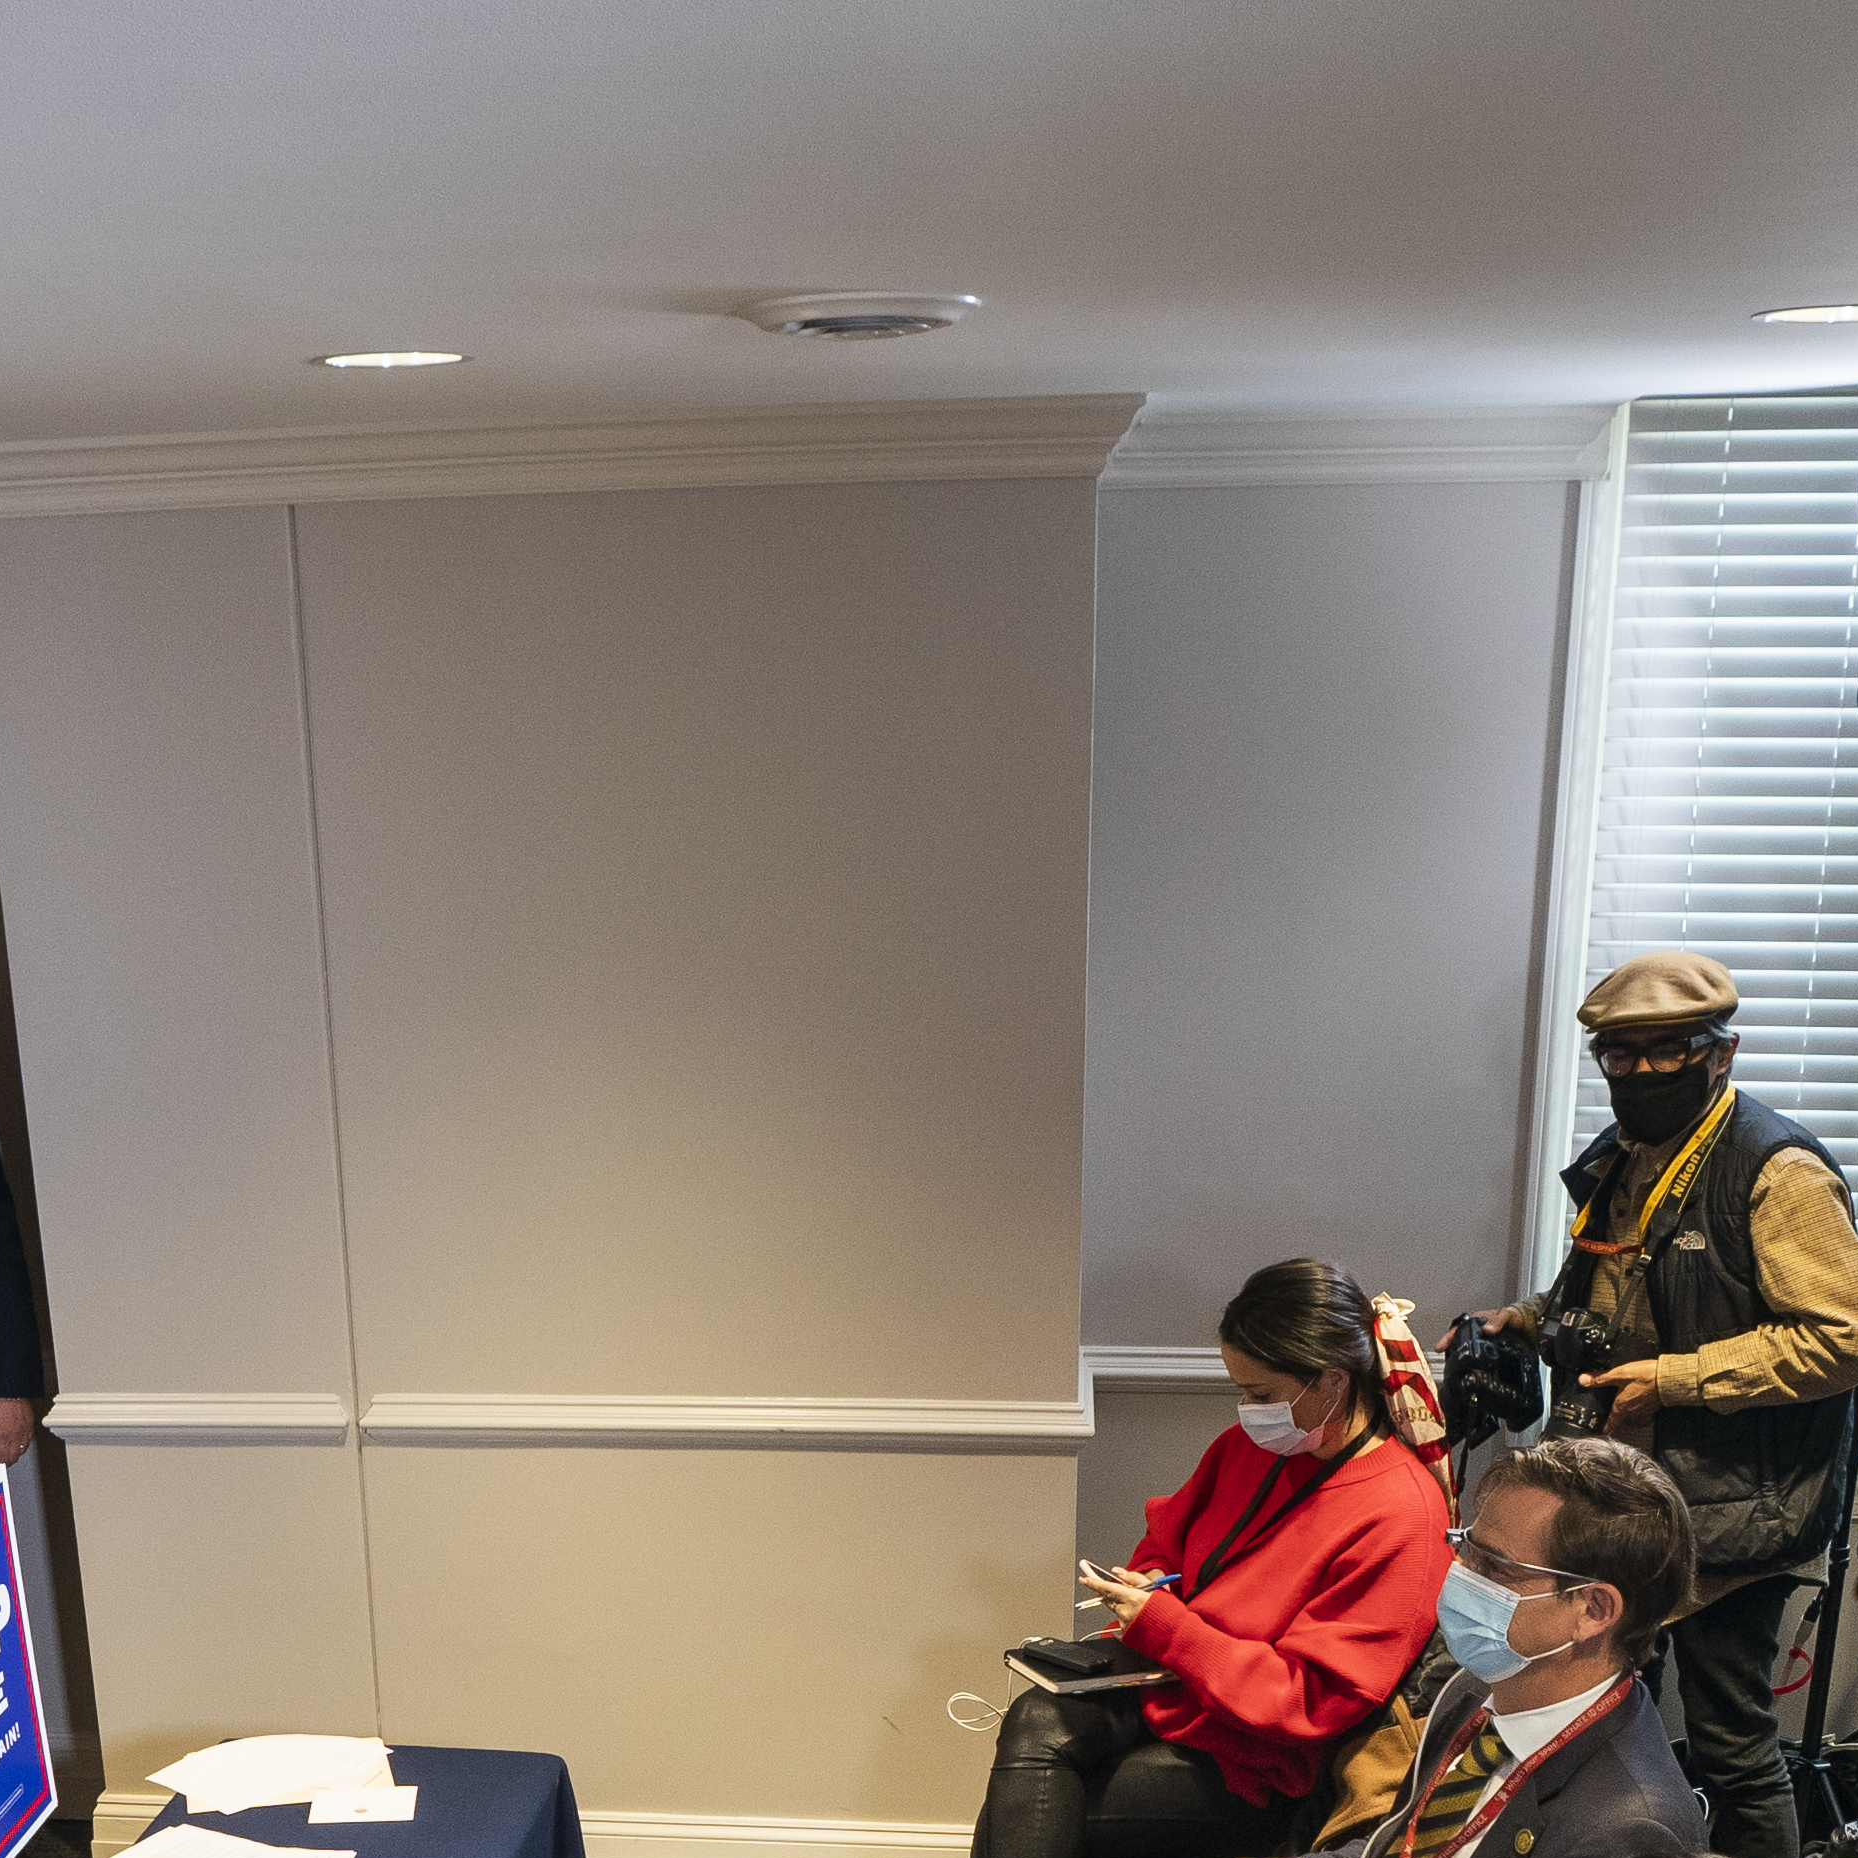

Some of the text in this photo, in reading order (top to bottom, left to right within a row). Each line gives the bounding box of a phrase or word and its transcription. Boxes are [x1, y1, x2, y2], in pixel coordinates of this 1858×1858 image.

[1670, 1153, 1701, 1198] Nikon
[1561, 1715, 1589, 1739] SENATE
[1587, 1708, 1597, 1720] ID
[1596, 1690, 1621, 1712] OFFICE
[1464, 1813, 1488, 1841] OFFICE
